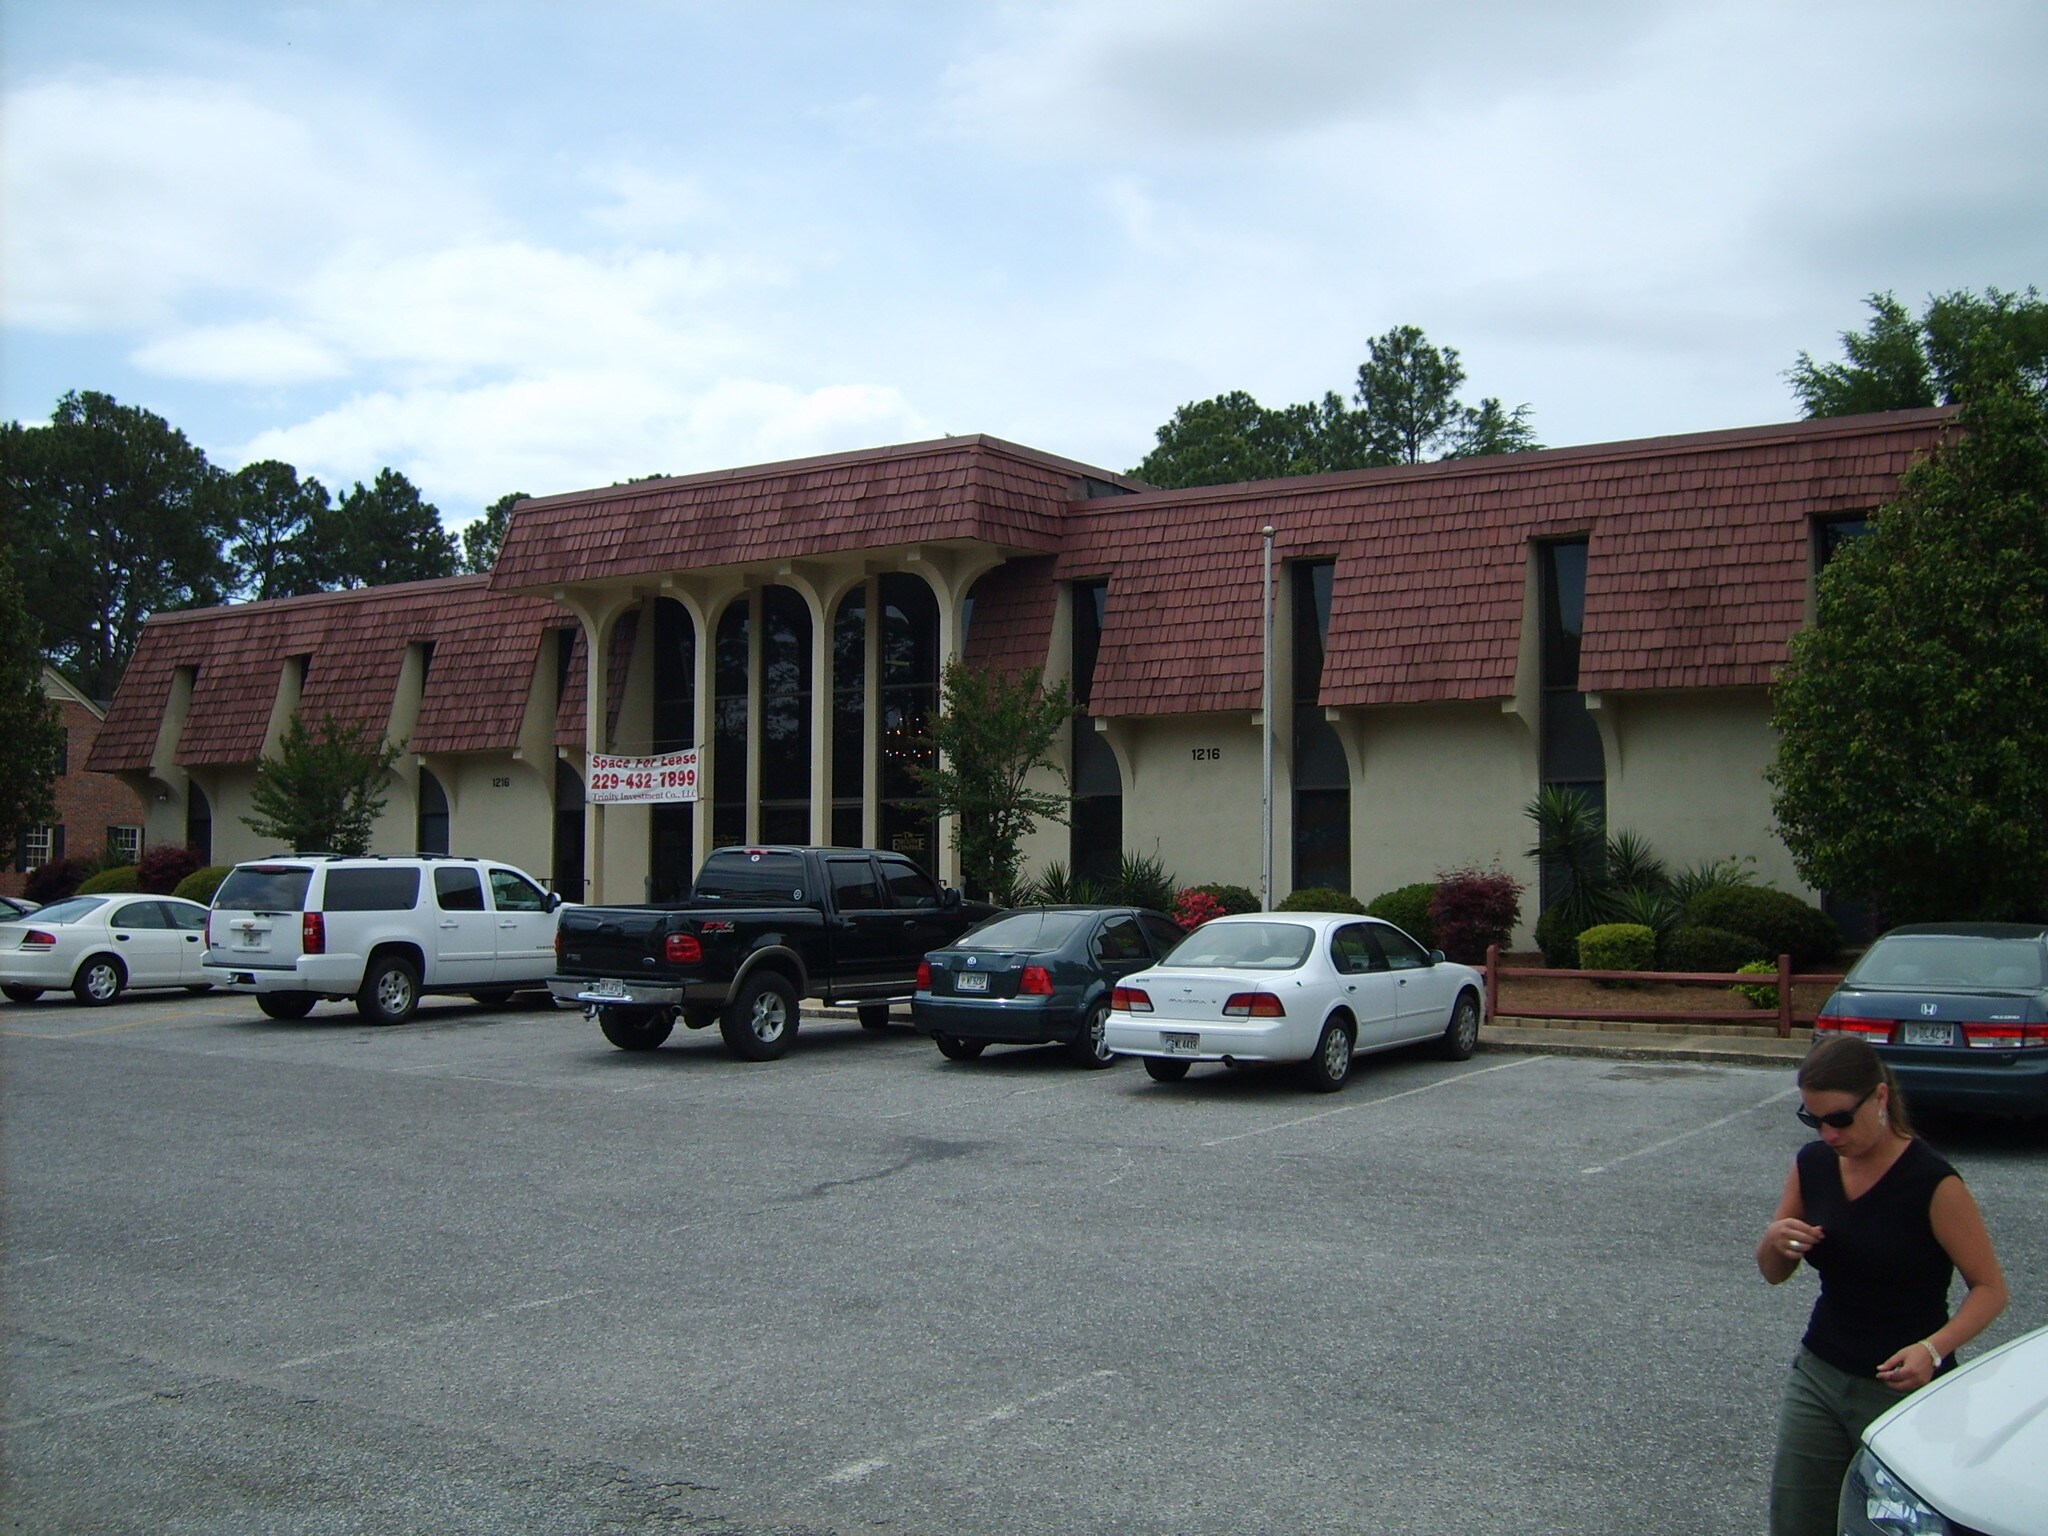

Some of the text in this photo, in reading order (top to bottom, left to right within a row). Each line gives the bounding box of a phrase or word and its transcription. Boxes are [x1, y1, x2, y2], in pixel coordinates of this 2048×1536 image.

[1191, 748, 1221, 760] 1216
[592, 753, 697, 770] Space For Lease
[492, 777, 510, 787] 1216
[591, 769, 696, 790] 229-432-7899
[592, 793, 618, 802] Trinity
[620, 793, 664, 801] Investment
[682, 789, 697, 799] LLC
[703, 921, 736, 930] FX4
